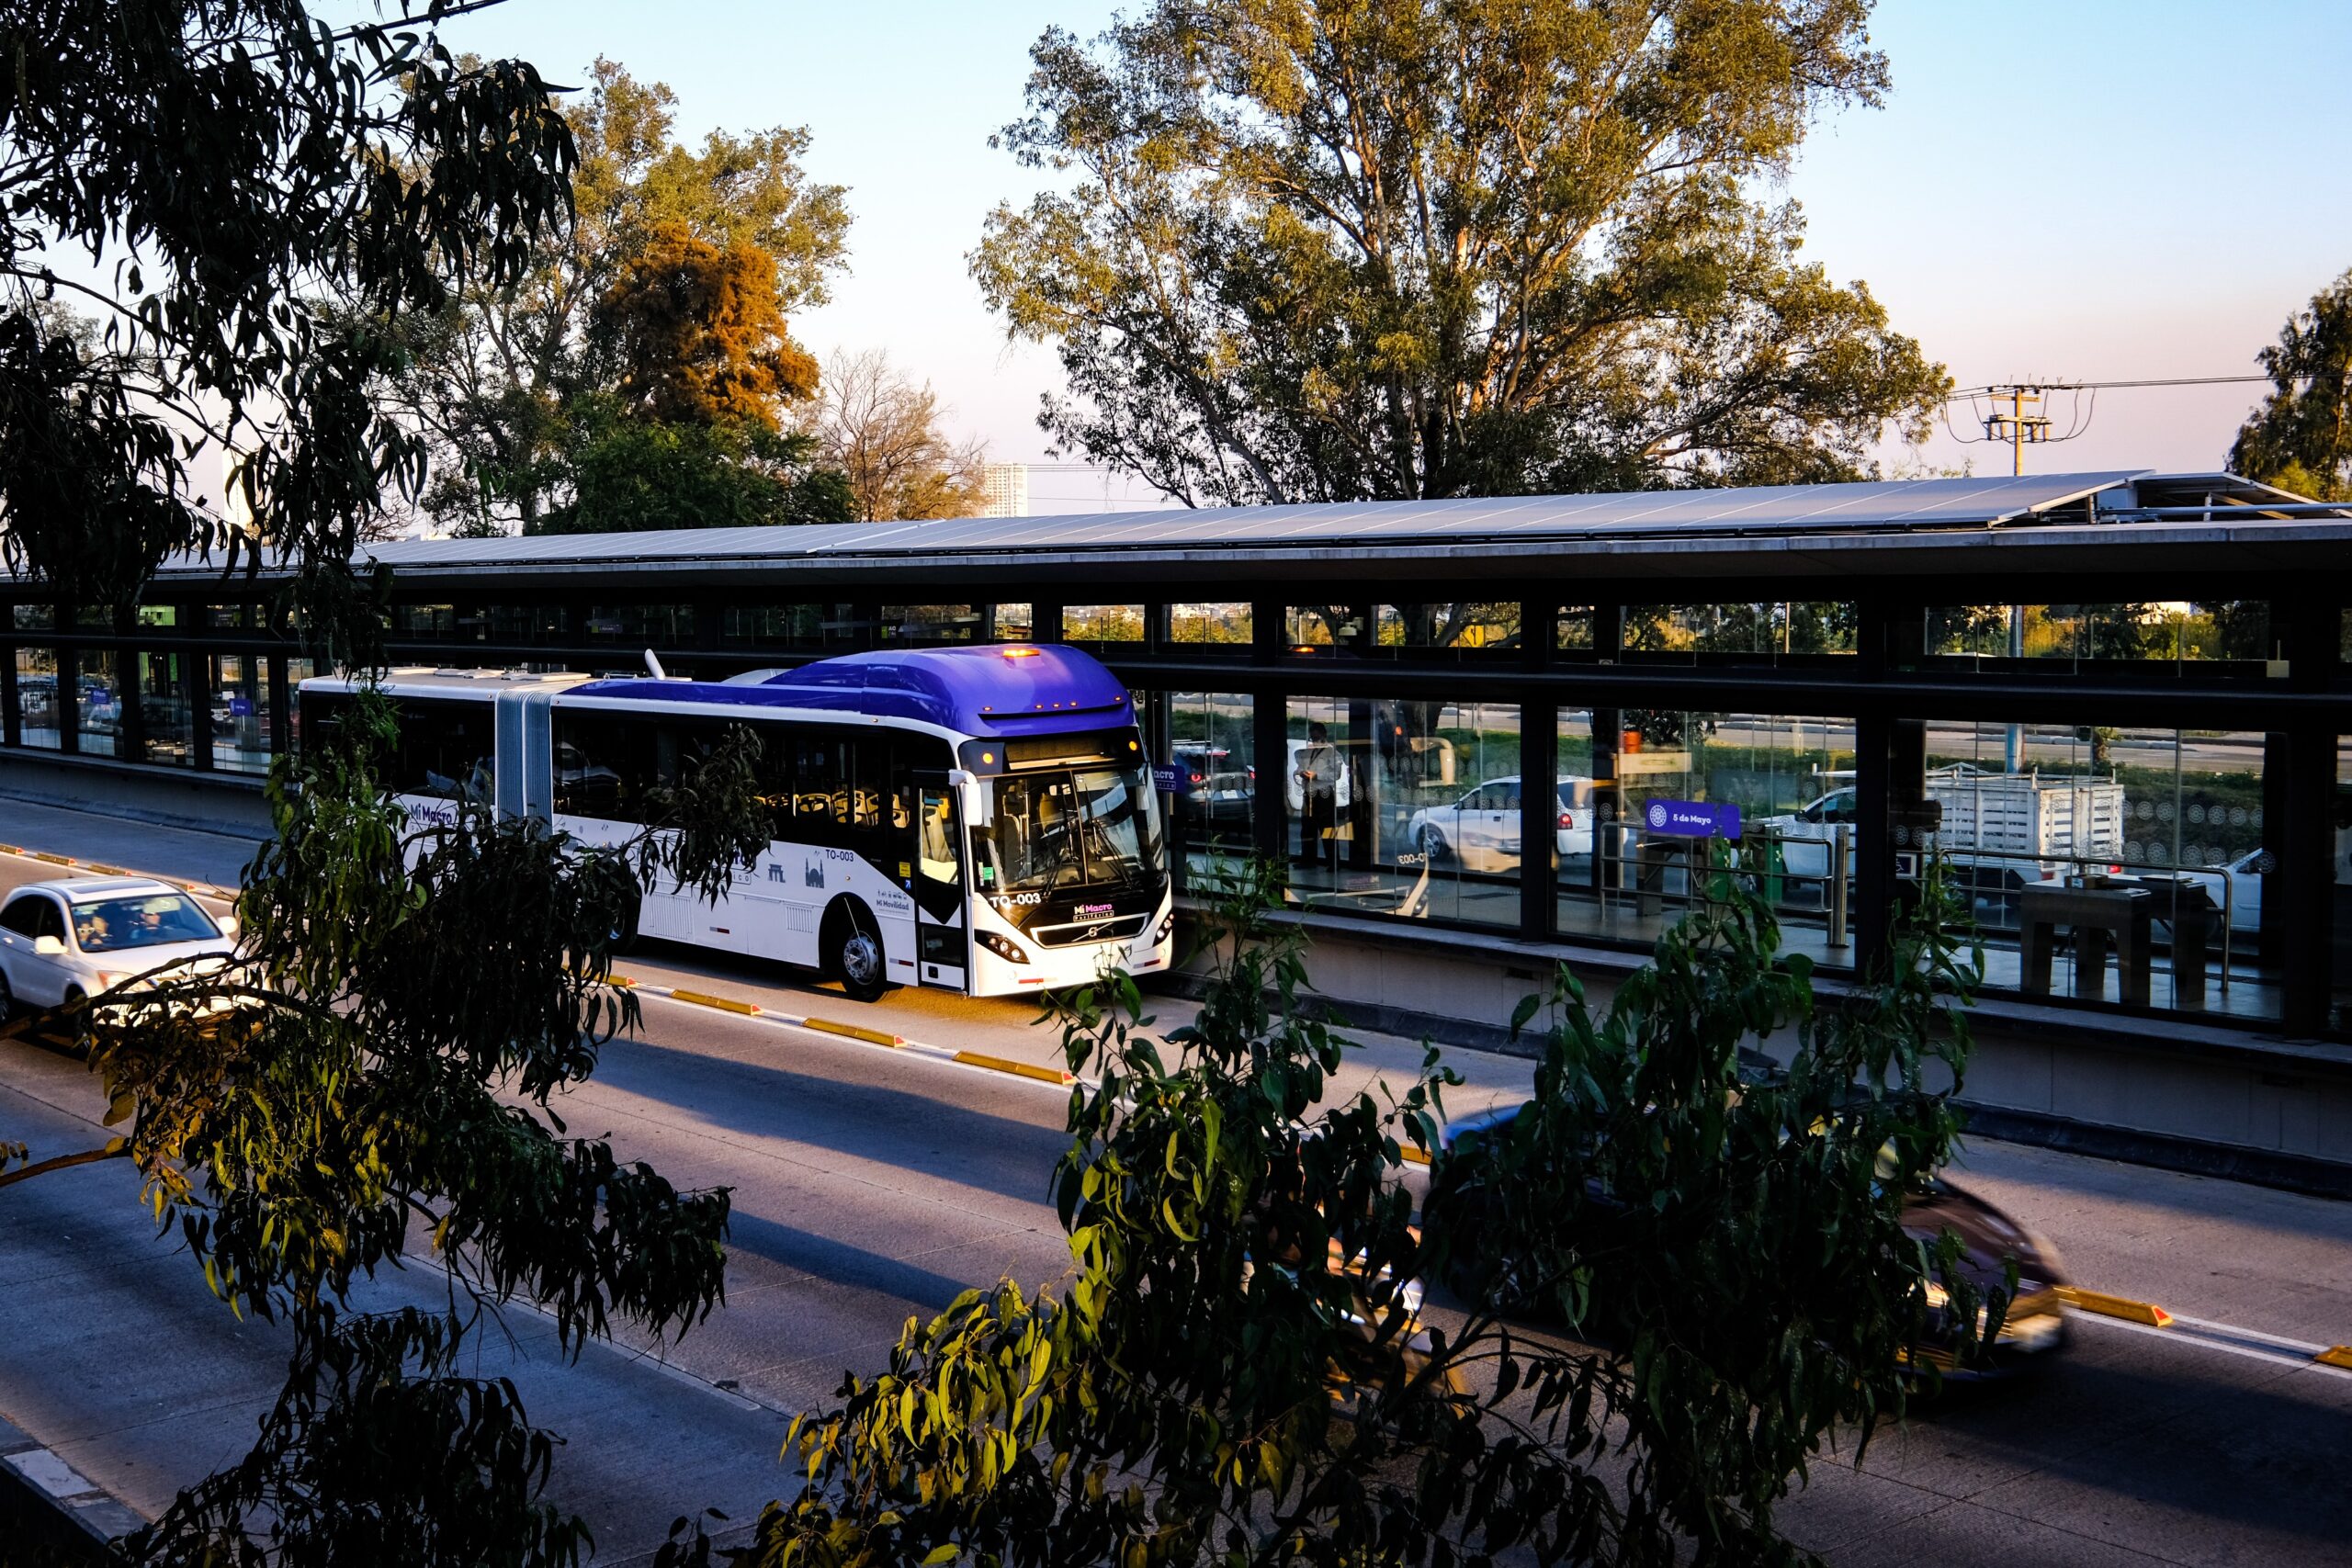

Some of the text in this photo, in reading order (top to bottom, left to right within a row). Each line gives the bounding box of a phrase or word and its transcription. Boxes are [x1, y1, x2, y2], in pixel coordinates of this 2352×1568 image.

[1154, 770, 1175, 780] acro
[411, 803, 452, 825] Mi Macro
[1673, 813, 1712, 826] 5 de Mayo
[826, 849, 854, 862] TO-003
[883, 899, 910, 910] Movilidad
[1074, 903, 1113, 915] Mi Macro
